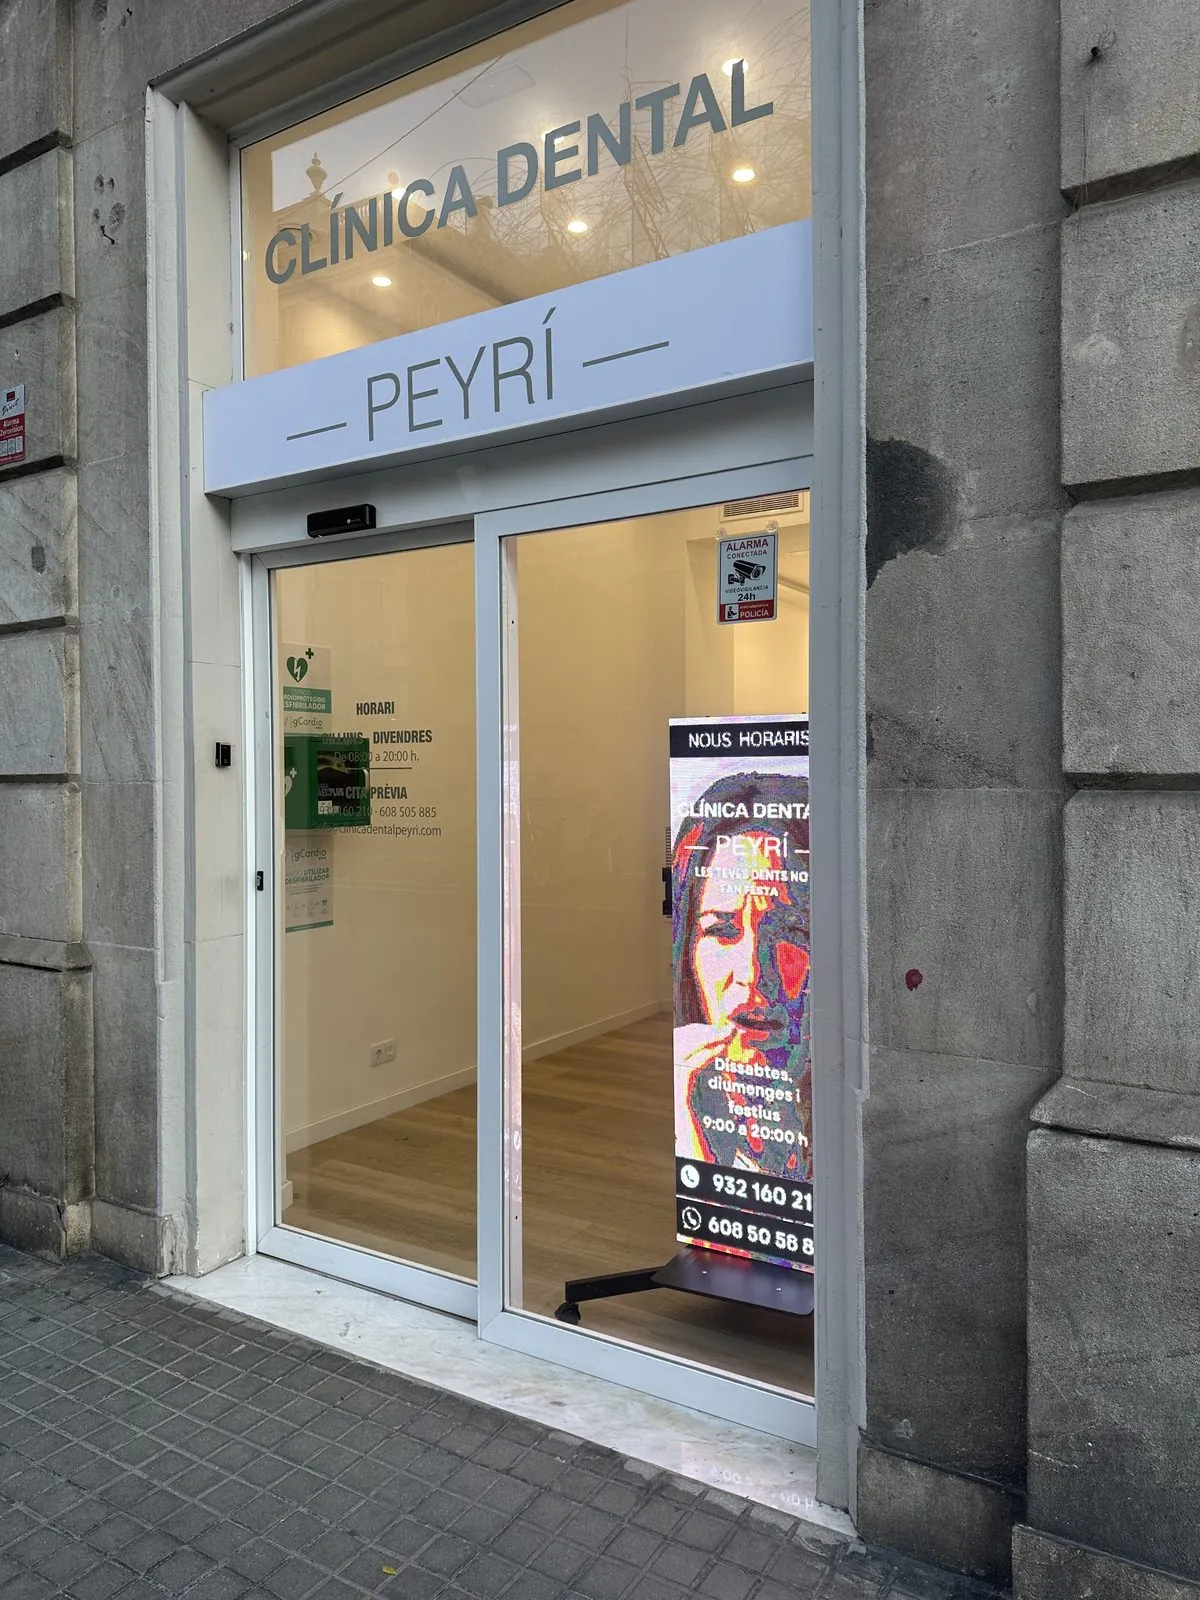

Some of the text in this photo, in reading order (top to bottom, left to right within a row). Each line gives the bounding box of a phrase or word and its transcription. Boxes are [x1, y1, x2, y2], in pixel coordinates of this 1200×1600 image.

[265, 60, 773, 284] CLÍNICA DENTAL
[367, 307, 557, 441] PEYRÍ
[726, 539, 769, 552] ALARMA
[727, 550, 767, 559] CONECTADA
[725, 585, 769, 593] VIDEOVIGILANCIA
[738, 593, 756, 601] 24h
[740, 609, 769, 618] POLICÍA
[356, 701, 395, 716] HORARI
[372, 730, 432, 744] DIVENDRES
[688, 730, 809, 748] NOUS HORARIS
[375, 753, 381, 762] a
[383, 751, 408, 762] 20:00
[411, 749, 420, 762] h.
[345, 783, 408, 800] CITA PRÈVIA
[380, 806, 396, 818] 608
[399, 806, 416, 818] 505
[419, 806, 437, 818] 885
[677, 799, 749, 819] CLÍNICA
[716, 832, 788, 859] PEYRÍ
[751, 869, 788, 882] DENTS
[790, 870, 809, 883] NO
[714, 1058, 794, 1083] Dissabtes,
[708, 1078, 793, 1101] diumenges
[728, 1100, 781, 1122] festius
[703, 1116, 735, 1134] 9:00
[738, 1125, 748, 1136] a
[751, 1125, 795, 1145] 20:00
[713, 1174, 748, 1199] 932
[752, 1182, 787, 1206] 160
[708, 1217, 744, 1239] 608
[747, 1225, 771, 1245] 50
[775, 1231, 799, 1252] 58
